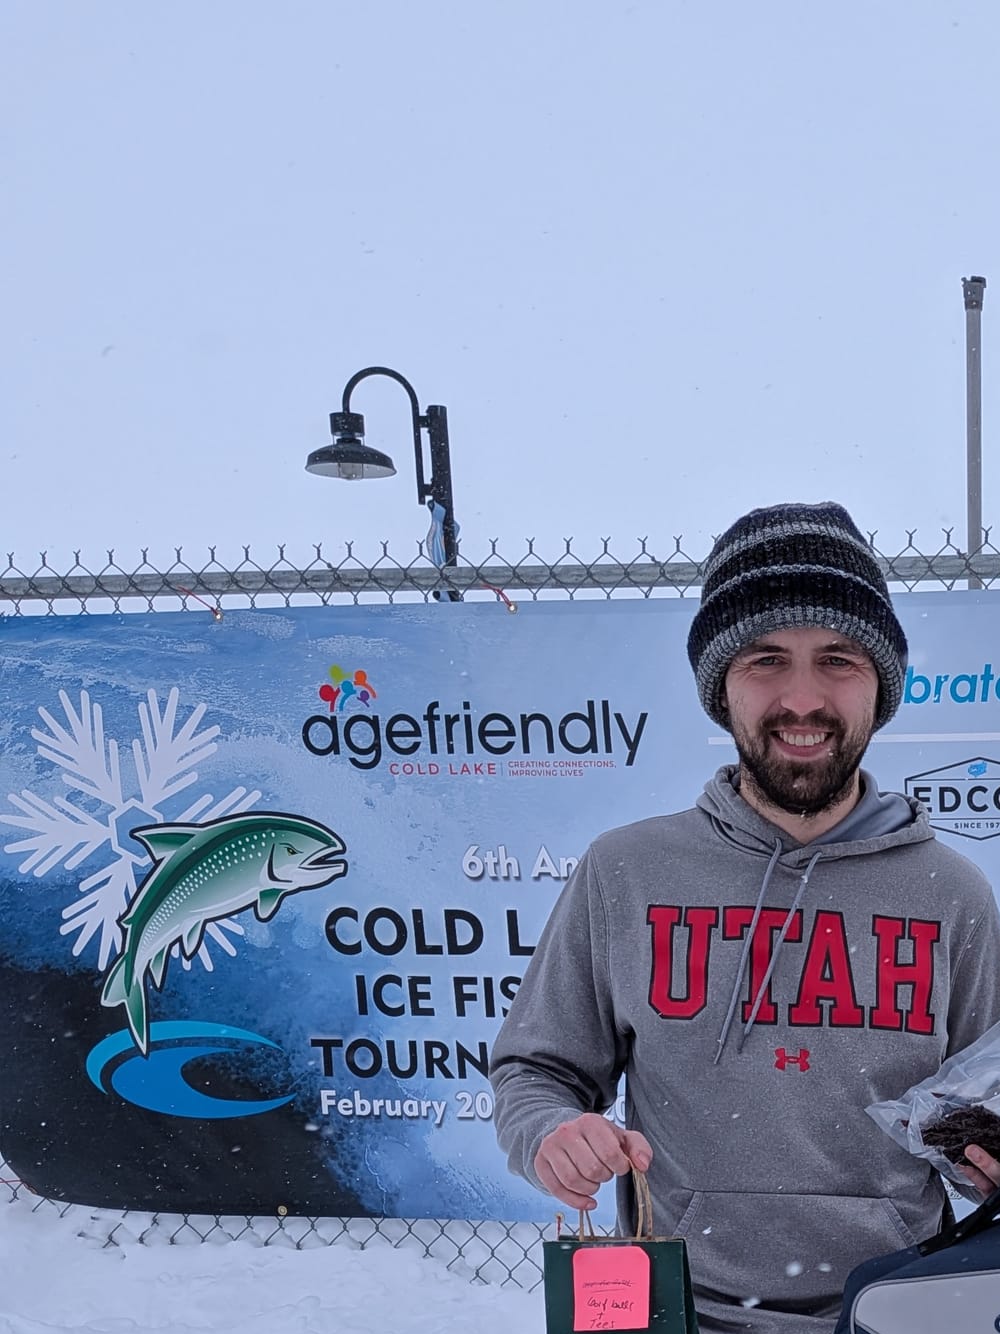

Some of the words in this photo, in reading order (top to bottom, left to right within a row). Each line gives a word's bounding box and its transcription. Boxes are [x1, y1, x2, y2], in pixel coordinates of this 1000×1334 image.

[302, 699, 648, 770] agefriendly
[390, 763, 440, 775] COLD
[450, 763, 497, 775] LAKE
[508, 760, 550, 769] CREATING
[553, 760, 617, 769] CONNECTIONS,
[509, 769, 557, 777] IMPROVING
[560, 769, 584, 777] LIVES
[954, 822, 982, 830] SINCE
[462, 845, 520, 880] 6th
[325, 907, 484, 955] COLD
[646, 903, 941, 1036] UTAH
[355, 975, 435, 1016] ICE
[320, 1090, 446, 1123] February
